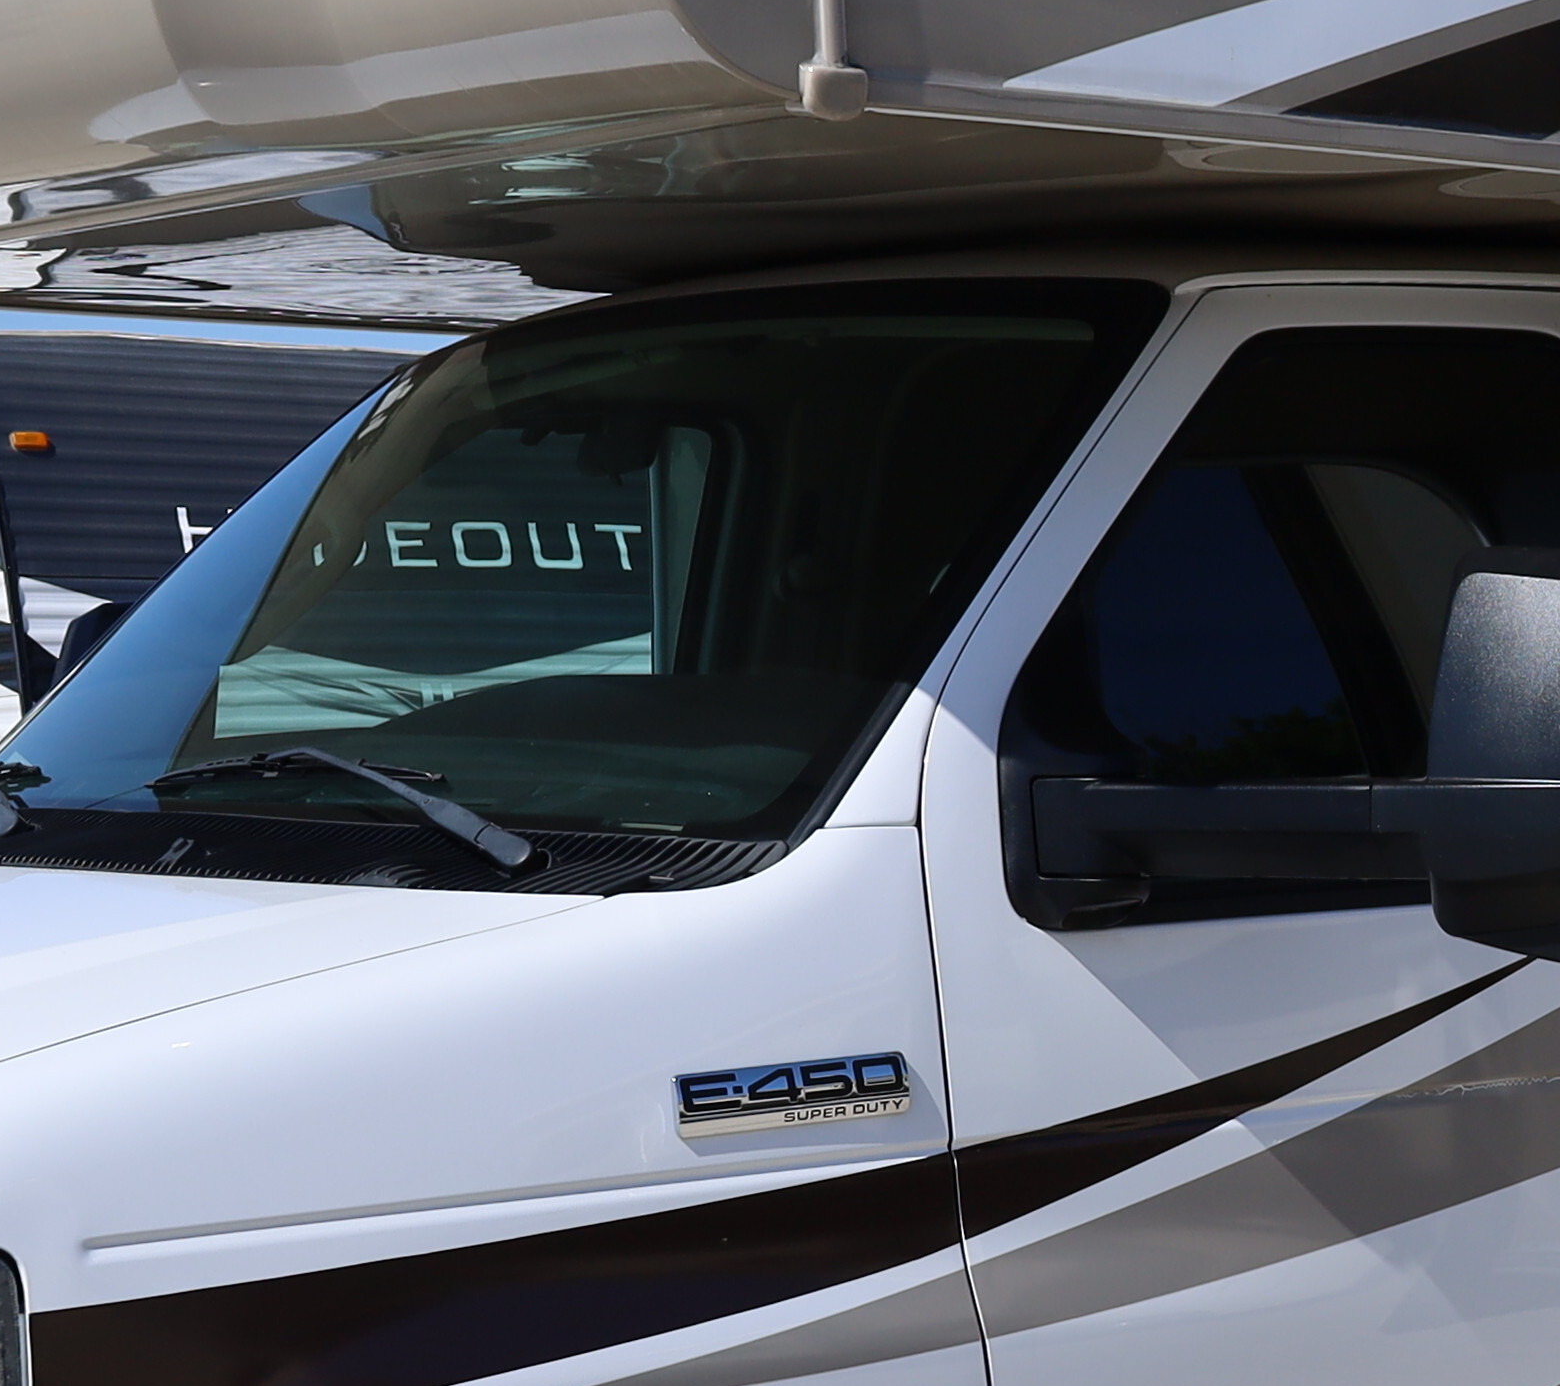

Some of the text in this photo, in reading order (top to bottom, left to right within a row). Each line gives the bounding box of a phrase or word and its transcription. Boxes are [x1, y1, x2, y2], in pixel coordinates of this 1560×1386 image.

[176, 507, 642, 570] HEOUT
[784, 1100, 903, 1122] SUPER DUTY
